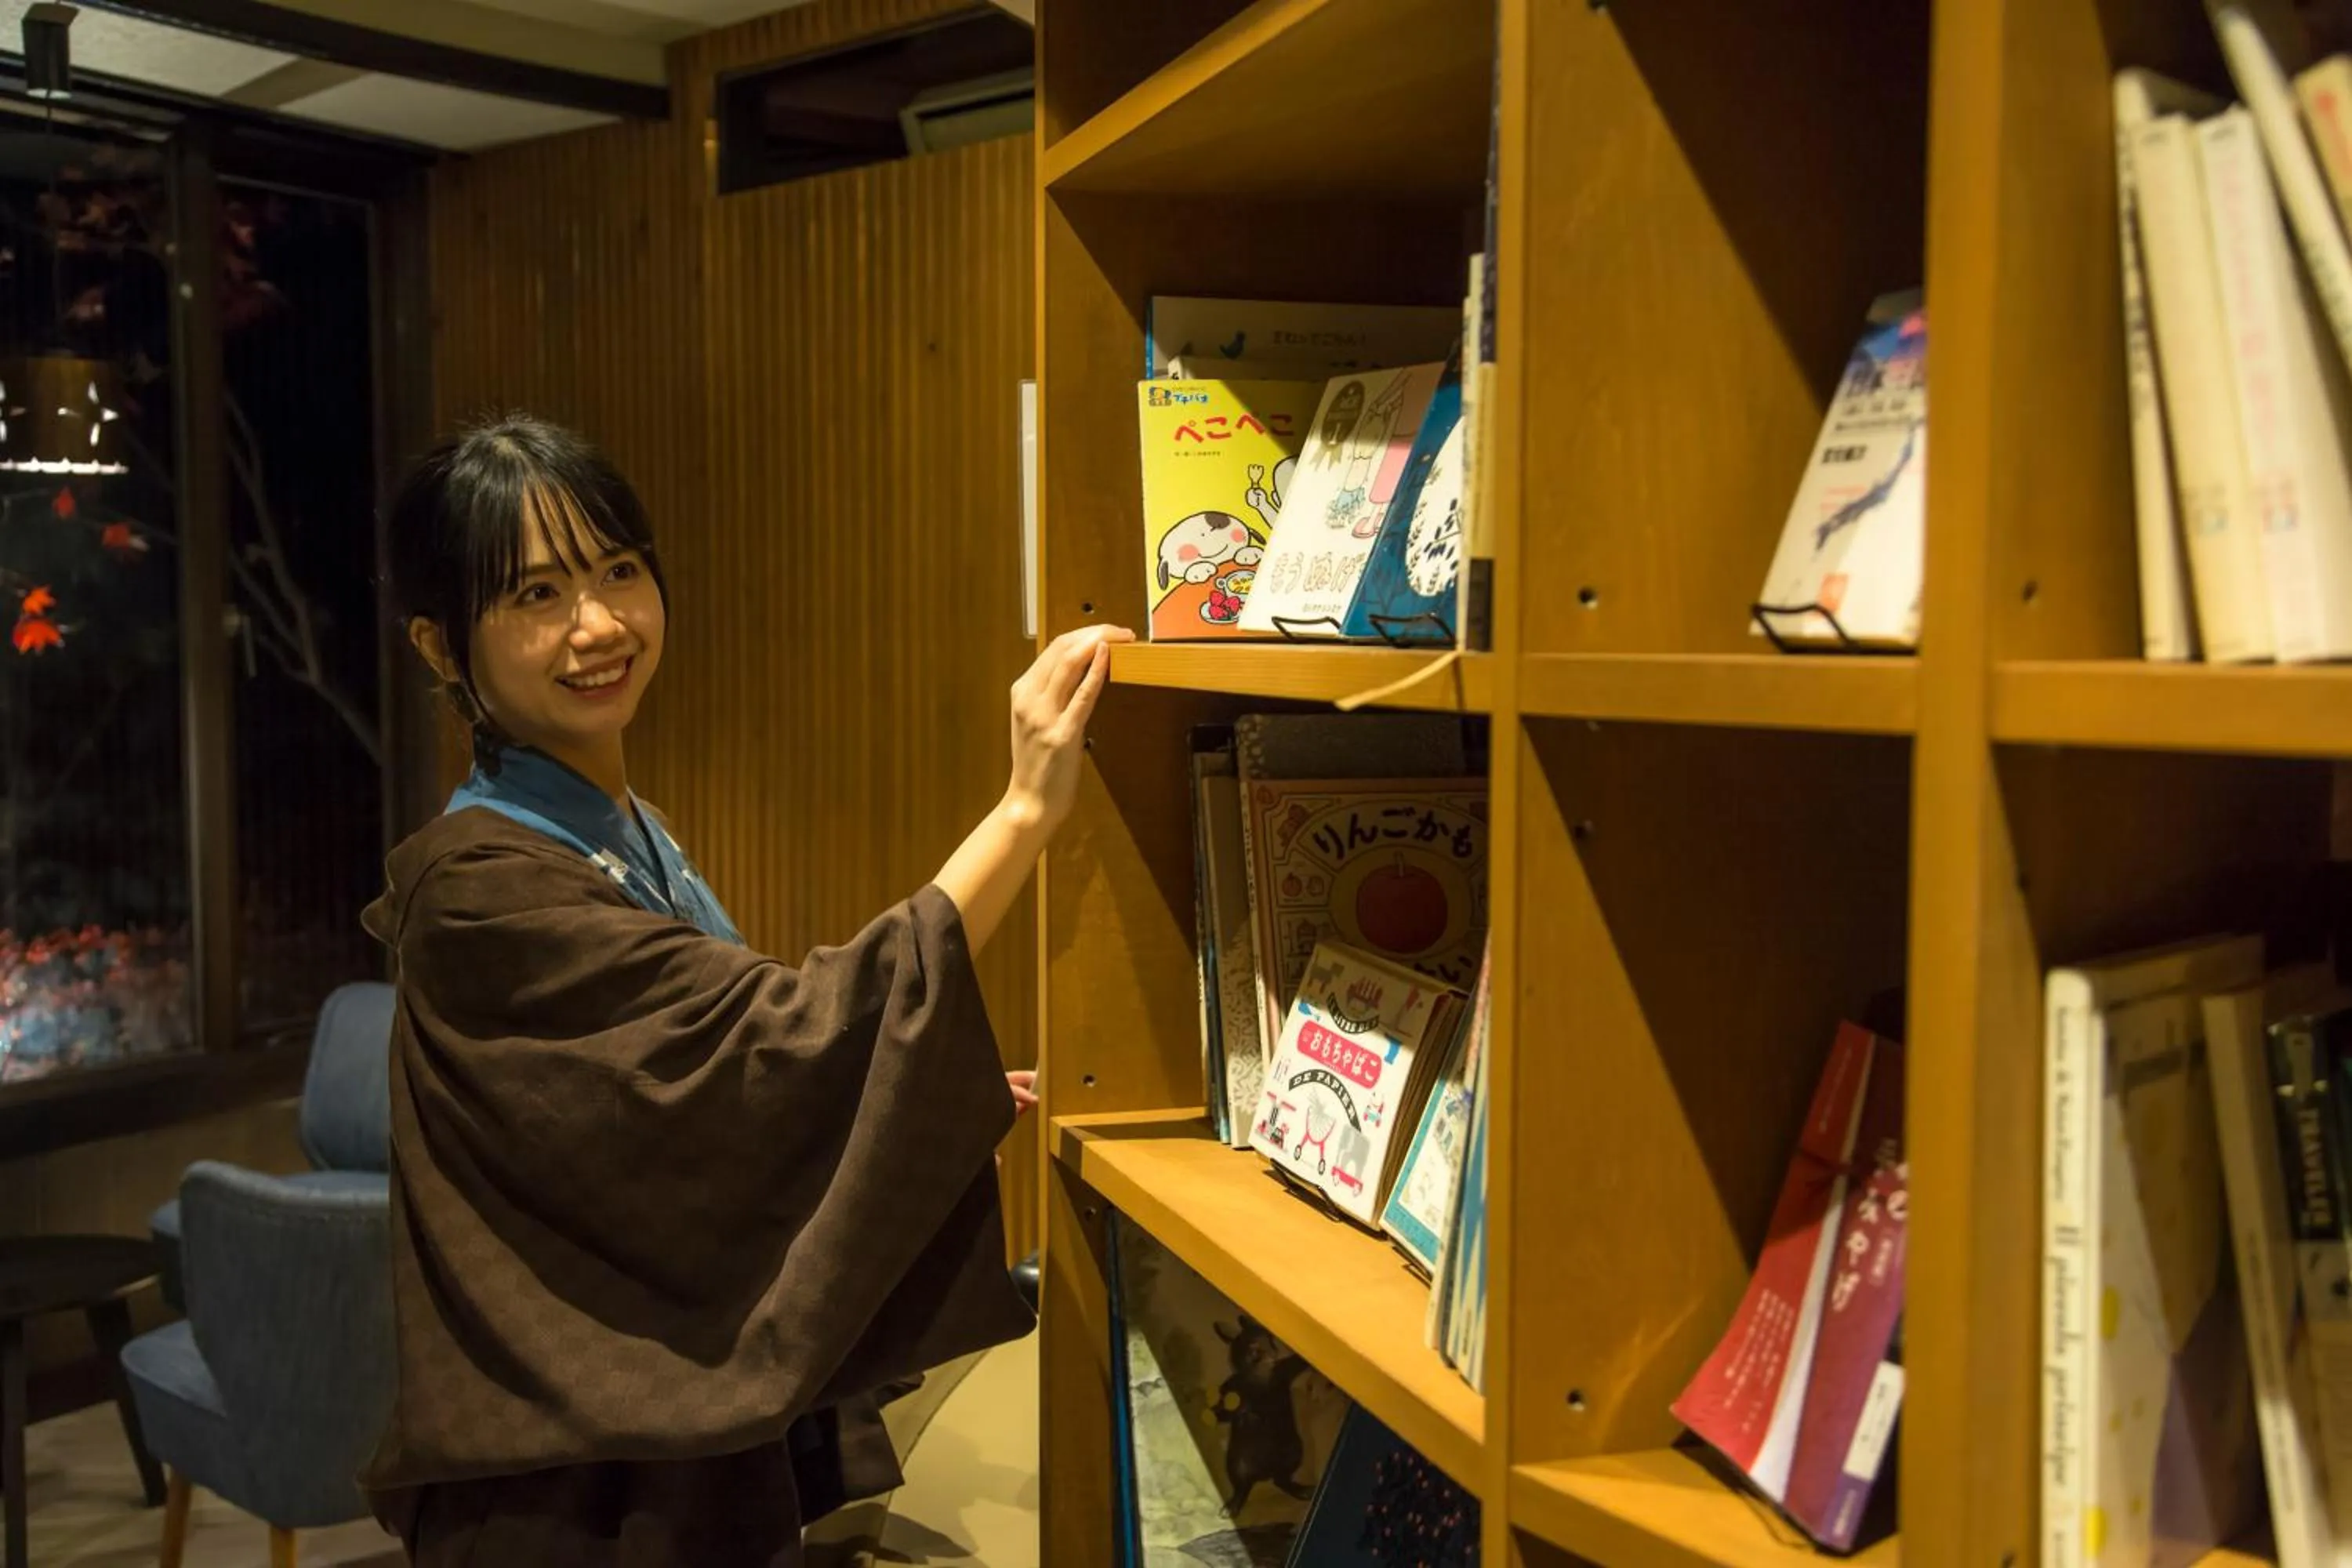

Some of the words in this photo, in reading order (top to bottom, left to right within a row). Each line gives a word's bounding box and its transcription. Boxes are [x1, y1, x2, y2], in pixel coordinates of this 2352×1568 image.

[1269, 550, 1367, 593] もうぬげ
[1312, 807, 1473, 861] りんごかも
[1310, 1029, 1378, 1082] おもちゃばこ
